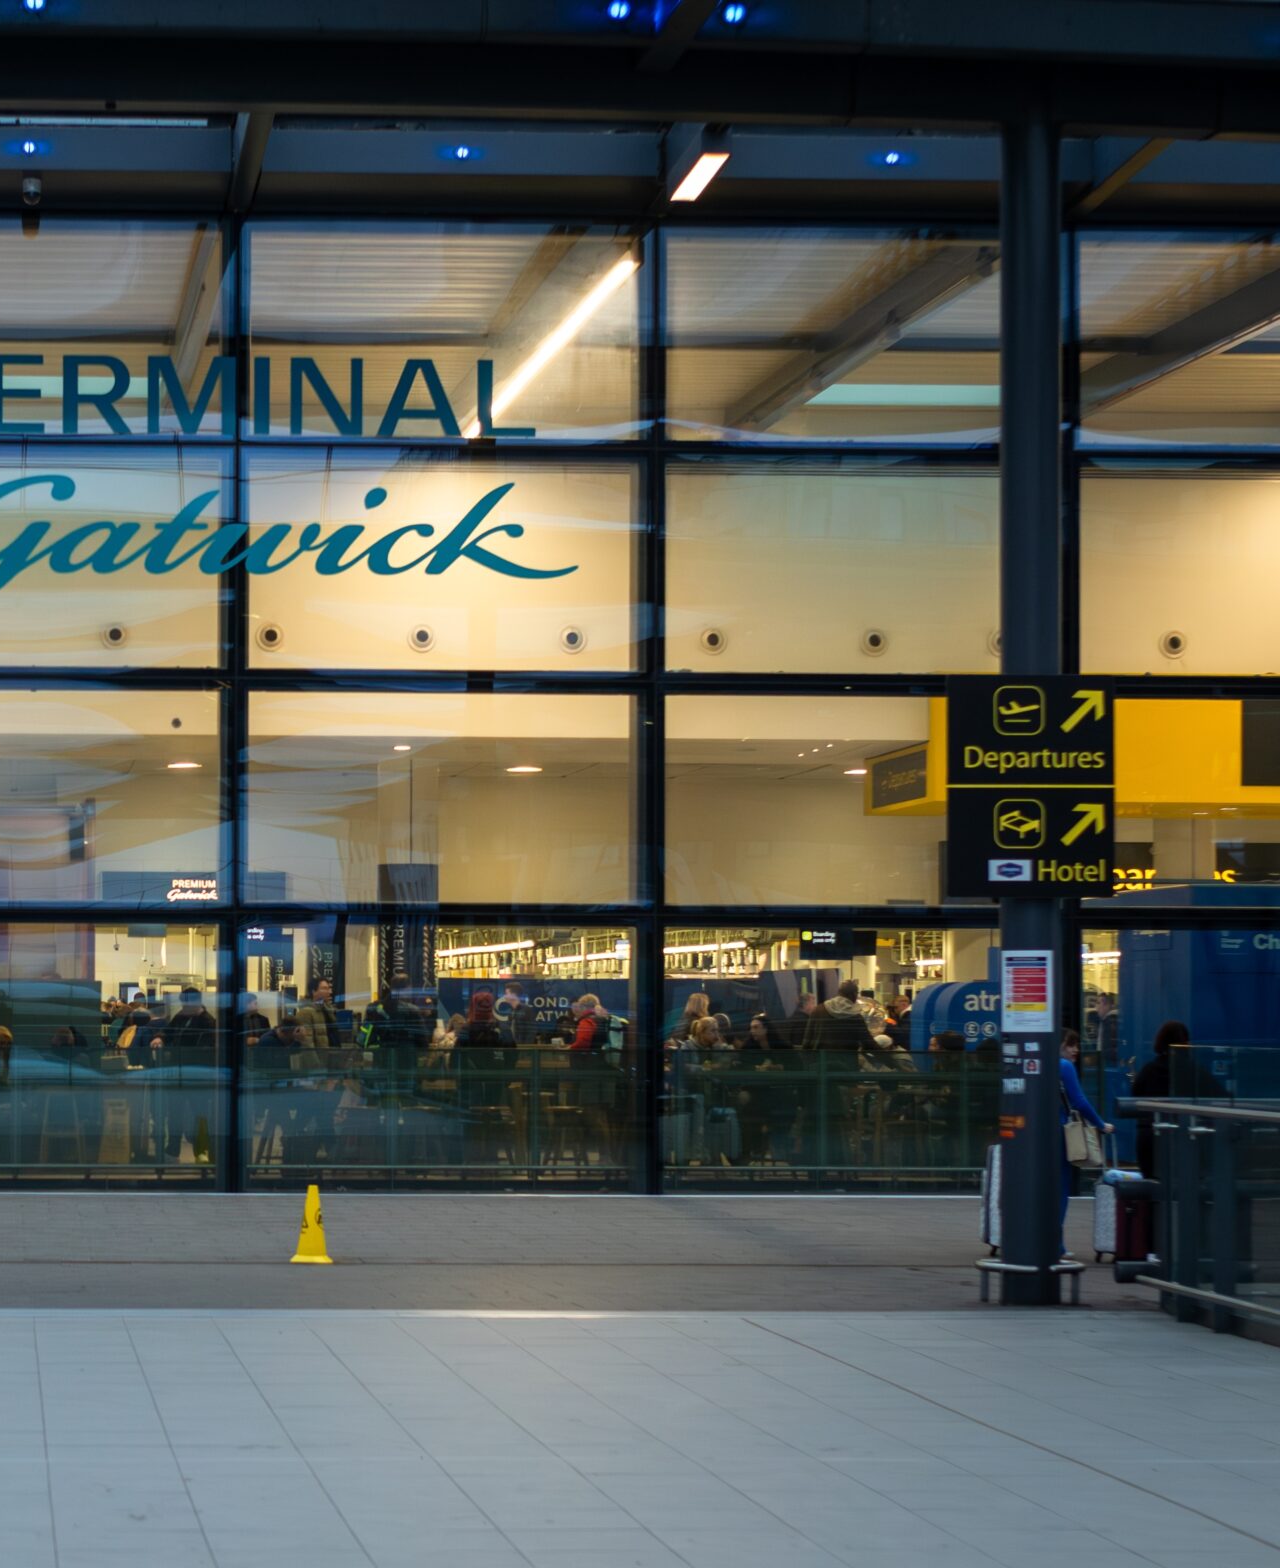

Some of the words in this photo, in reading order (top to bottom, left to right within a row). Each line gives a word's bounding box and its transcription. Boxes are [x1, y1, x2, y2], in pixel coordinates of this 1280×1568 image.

[963, 745, 1106, 774] Departures
[1037, 859, 1106, 882] Hotel
[172, 879, 216, 888] PREMIUM
[166, 888, 218, 902] Gatwick
